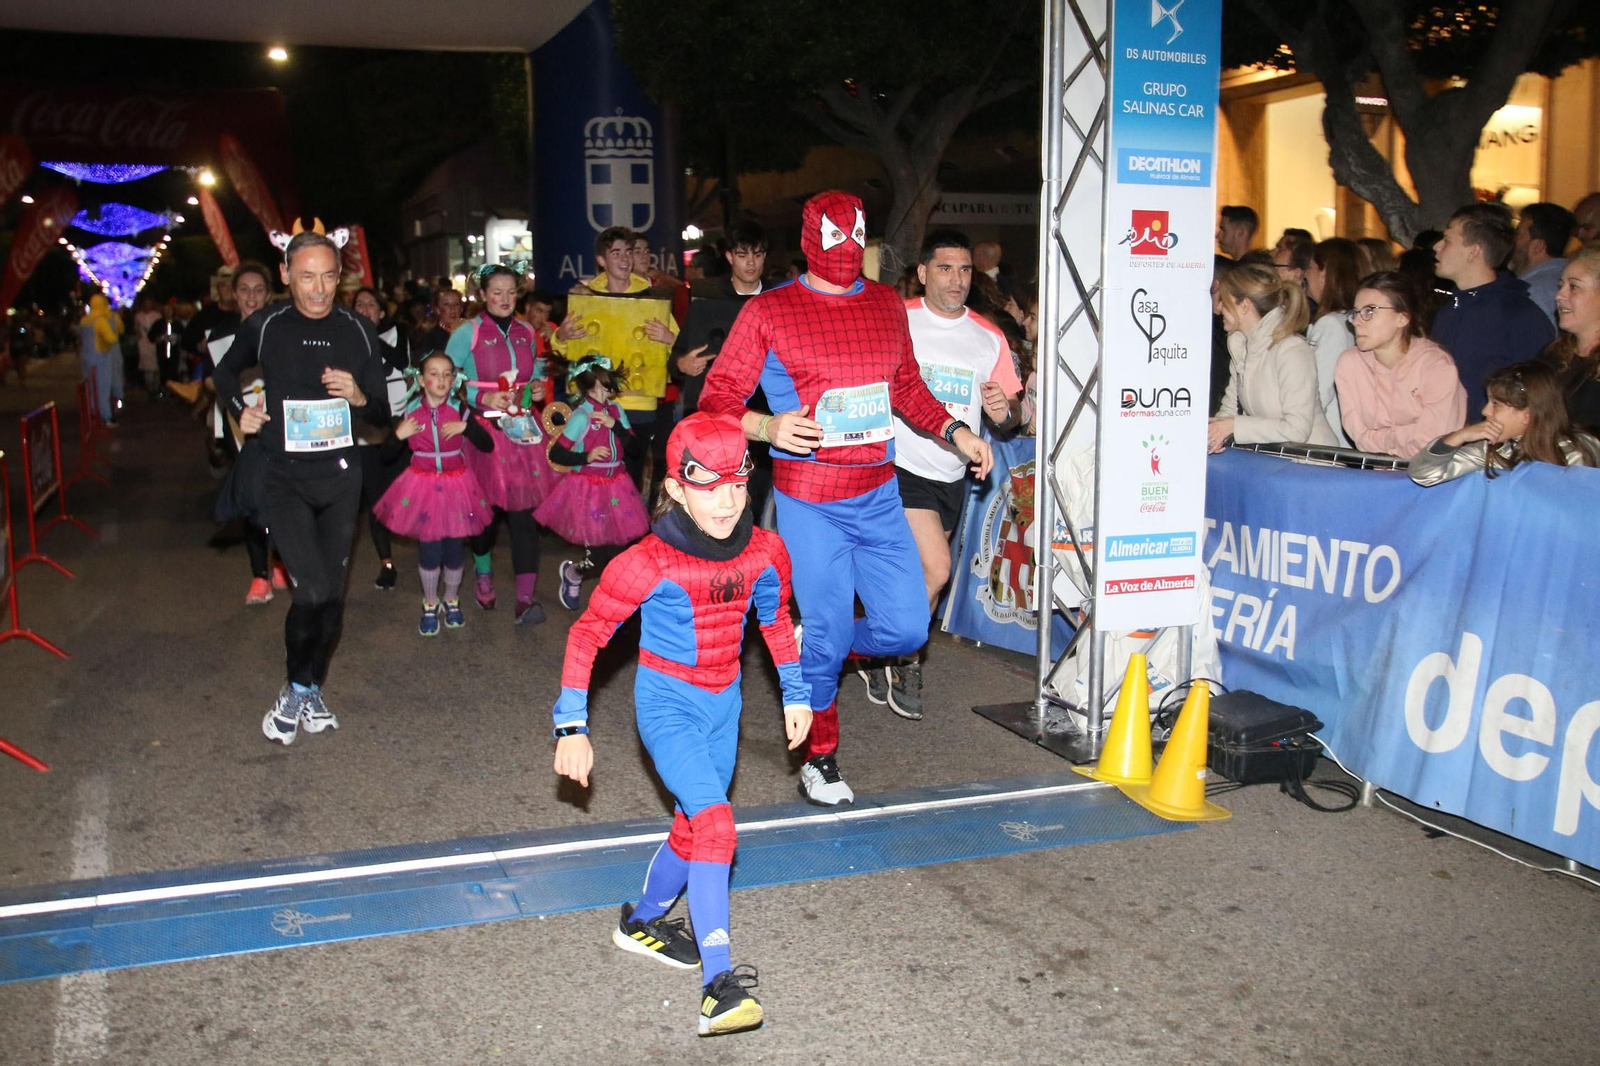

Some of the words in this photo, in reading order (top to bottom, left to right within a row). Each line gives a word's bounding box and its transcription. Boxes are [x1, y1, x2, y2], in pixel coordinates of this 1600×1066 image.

[1126, 48, 1139, 59] DS
[1142, 50, 1207, 65] AUTOMOBILES
[1143, 82, 1187, 98] GRUPO
[1123, 100, 1176, 116] SALINAS
[1179, 103, 1204, 118] CAR
[1128, 156, 1201, 174] DECATHLON
[933, 379, 969, 397] 2416
[1121, 387, 1191, 409] DUNA
[847, 398, 887, 419] 2004
[1120, 409, 1191, 418] reformasduna.com
[317, 412, 343, 429] 386
[1141, 486, 1169, 496] BUEN
[1109, 538, 1169, 558] Almericar
[1105, 583, 1119, 594] La
[1120, 582, 1140, 592] Voz
[1140, 580, 1153, 591] de
[1154, 576, 1194, 590] Almería
